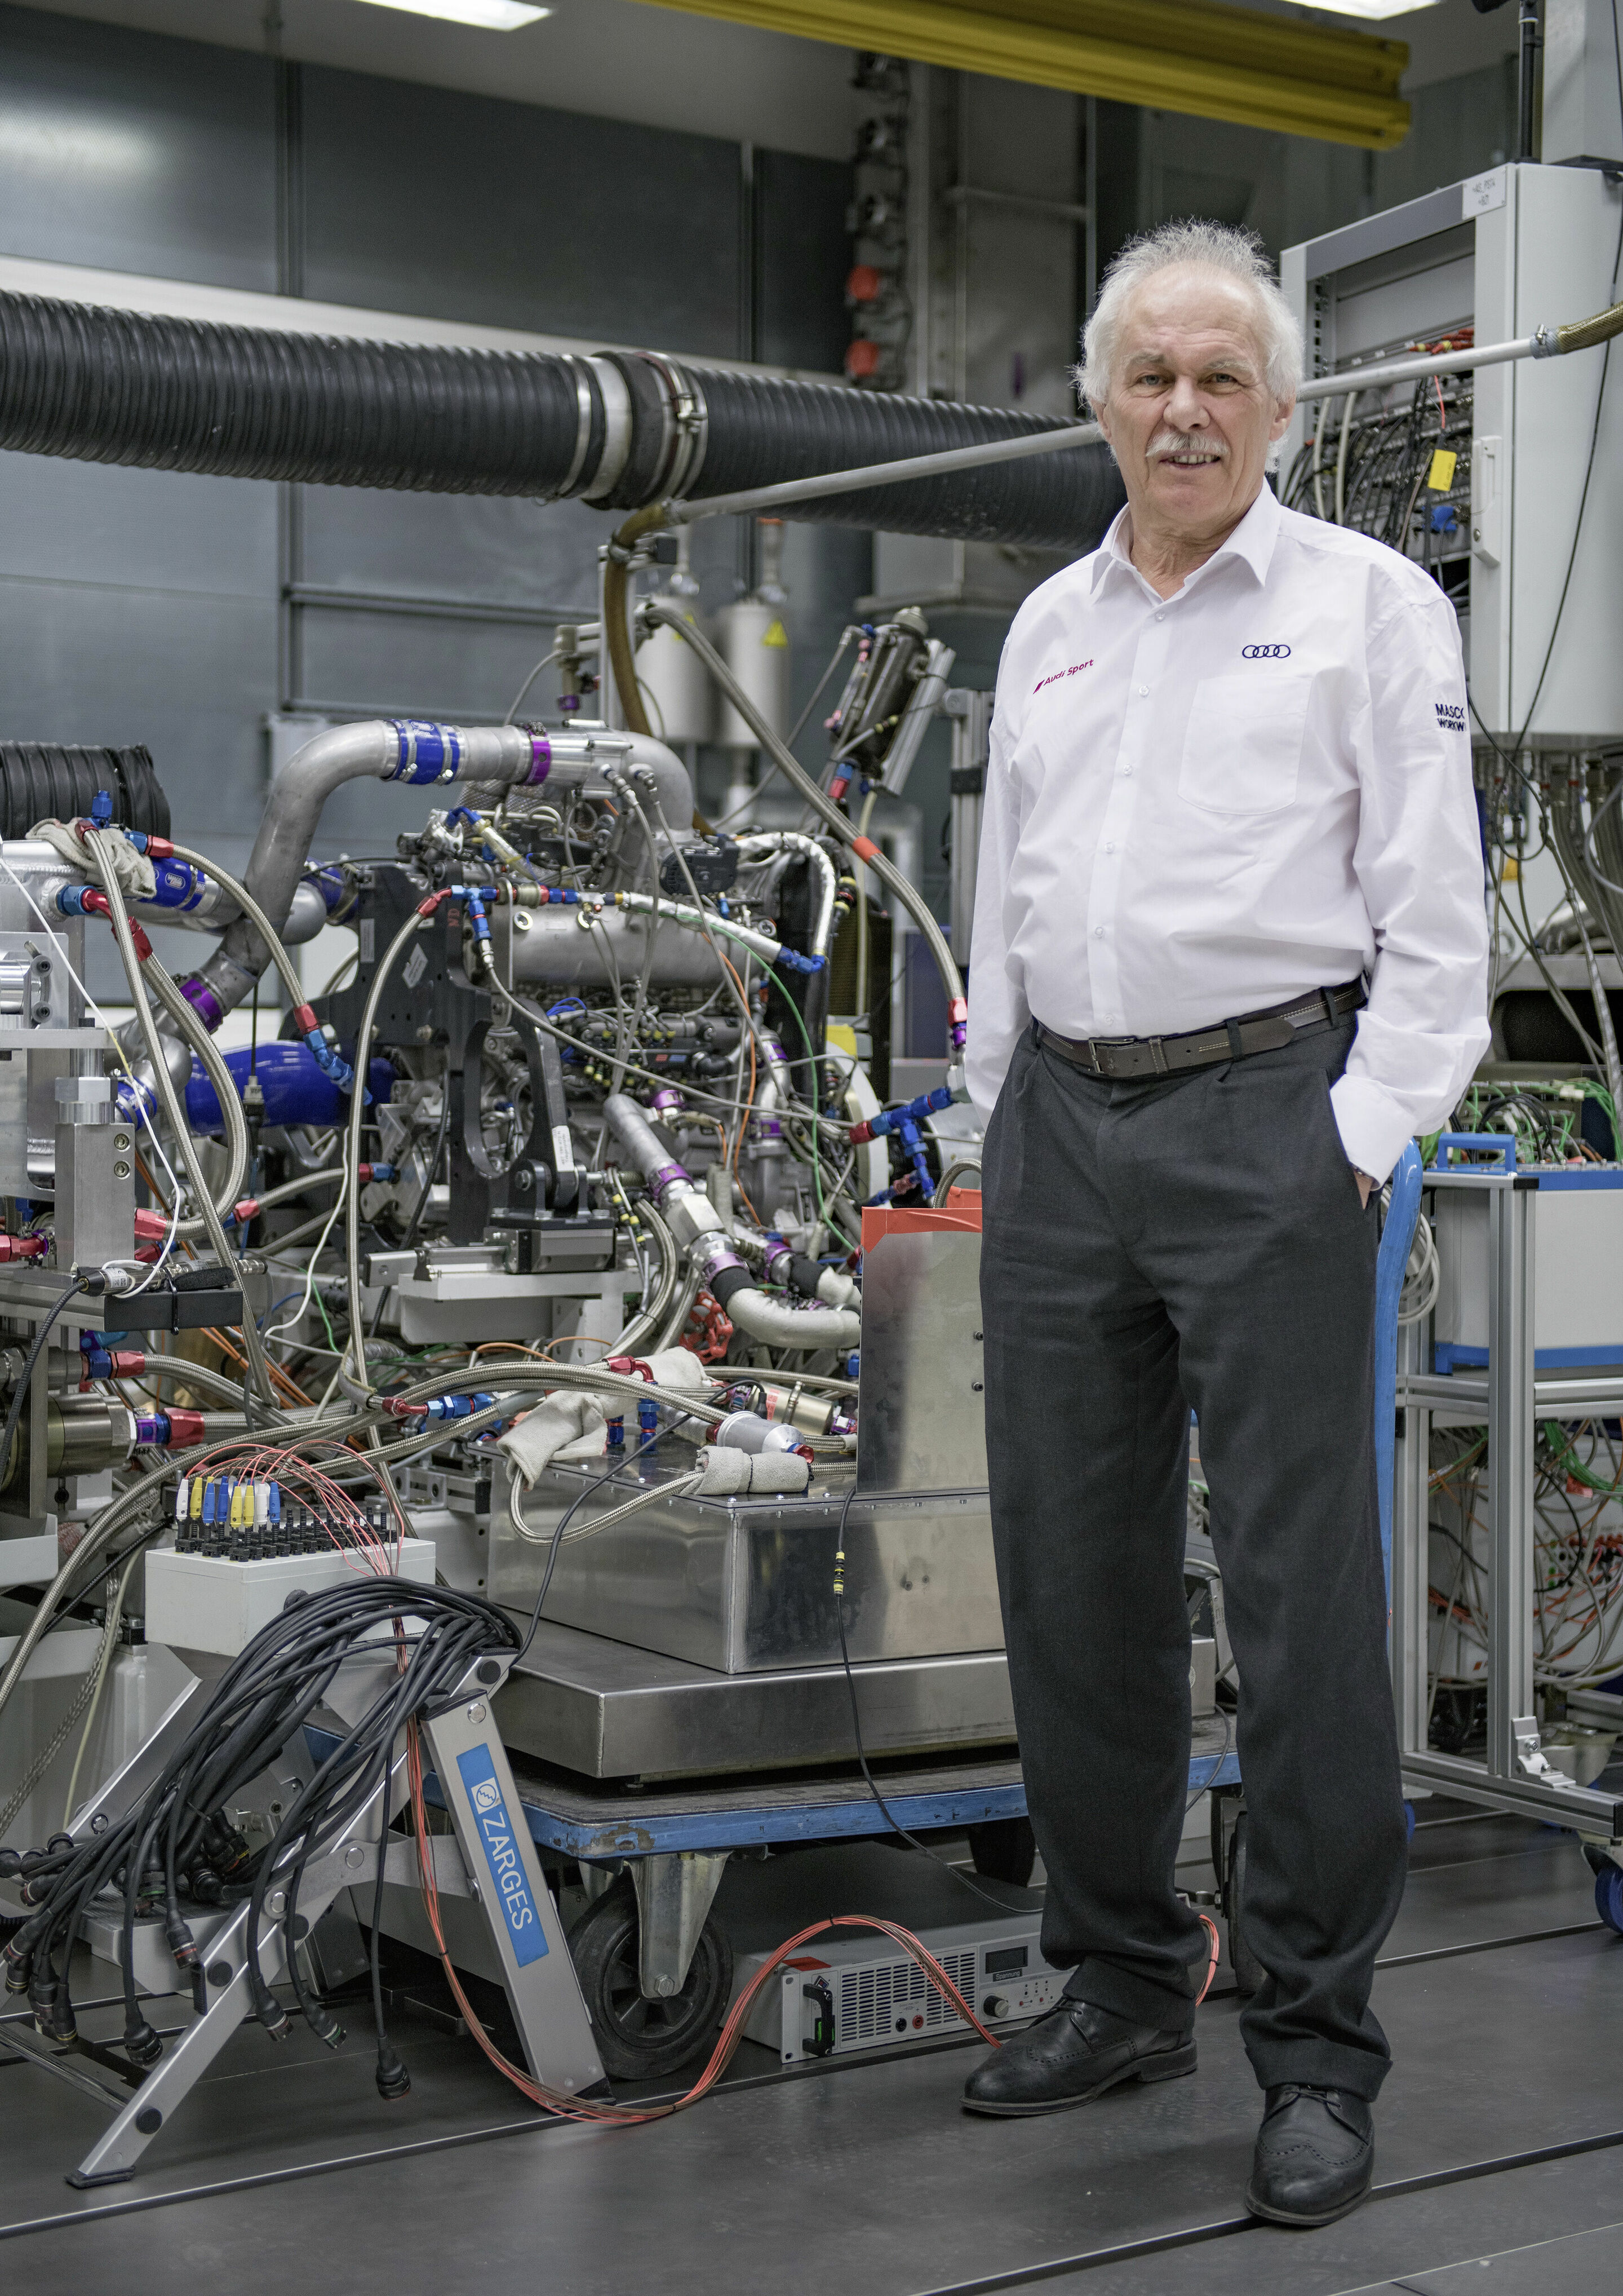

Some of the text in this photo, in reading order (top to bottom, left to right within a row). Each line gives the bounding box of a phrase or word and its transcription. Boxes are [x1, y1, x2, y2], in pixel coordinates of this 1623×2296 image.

[1043, 658, 1094, 686] Audi Sport
[1437, 718, 1466, 732] WORKW
[481, 1811, 533, 1930] ZARGES
[995, 1971, 1020, 1980] Spannung
